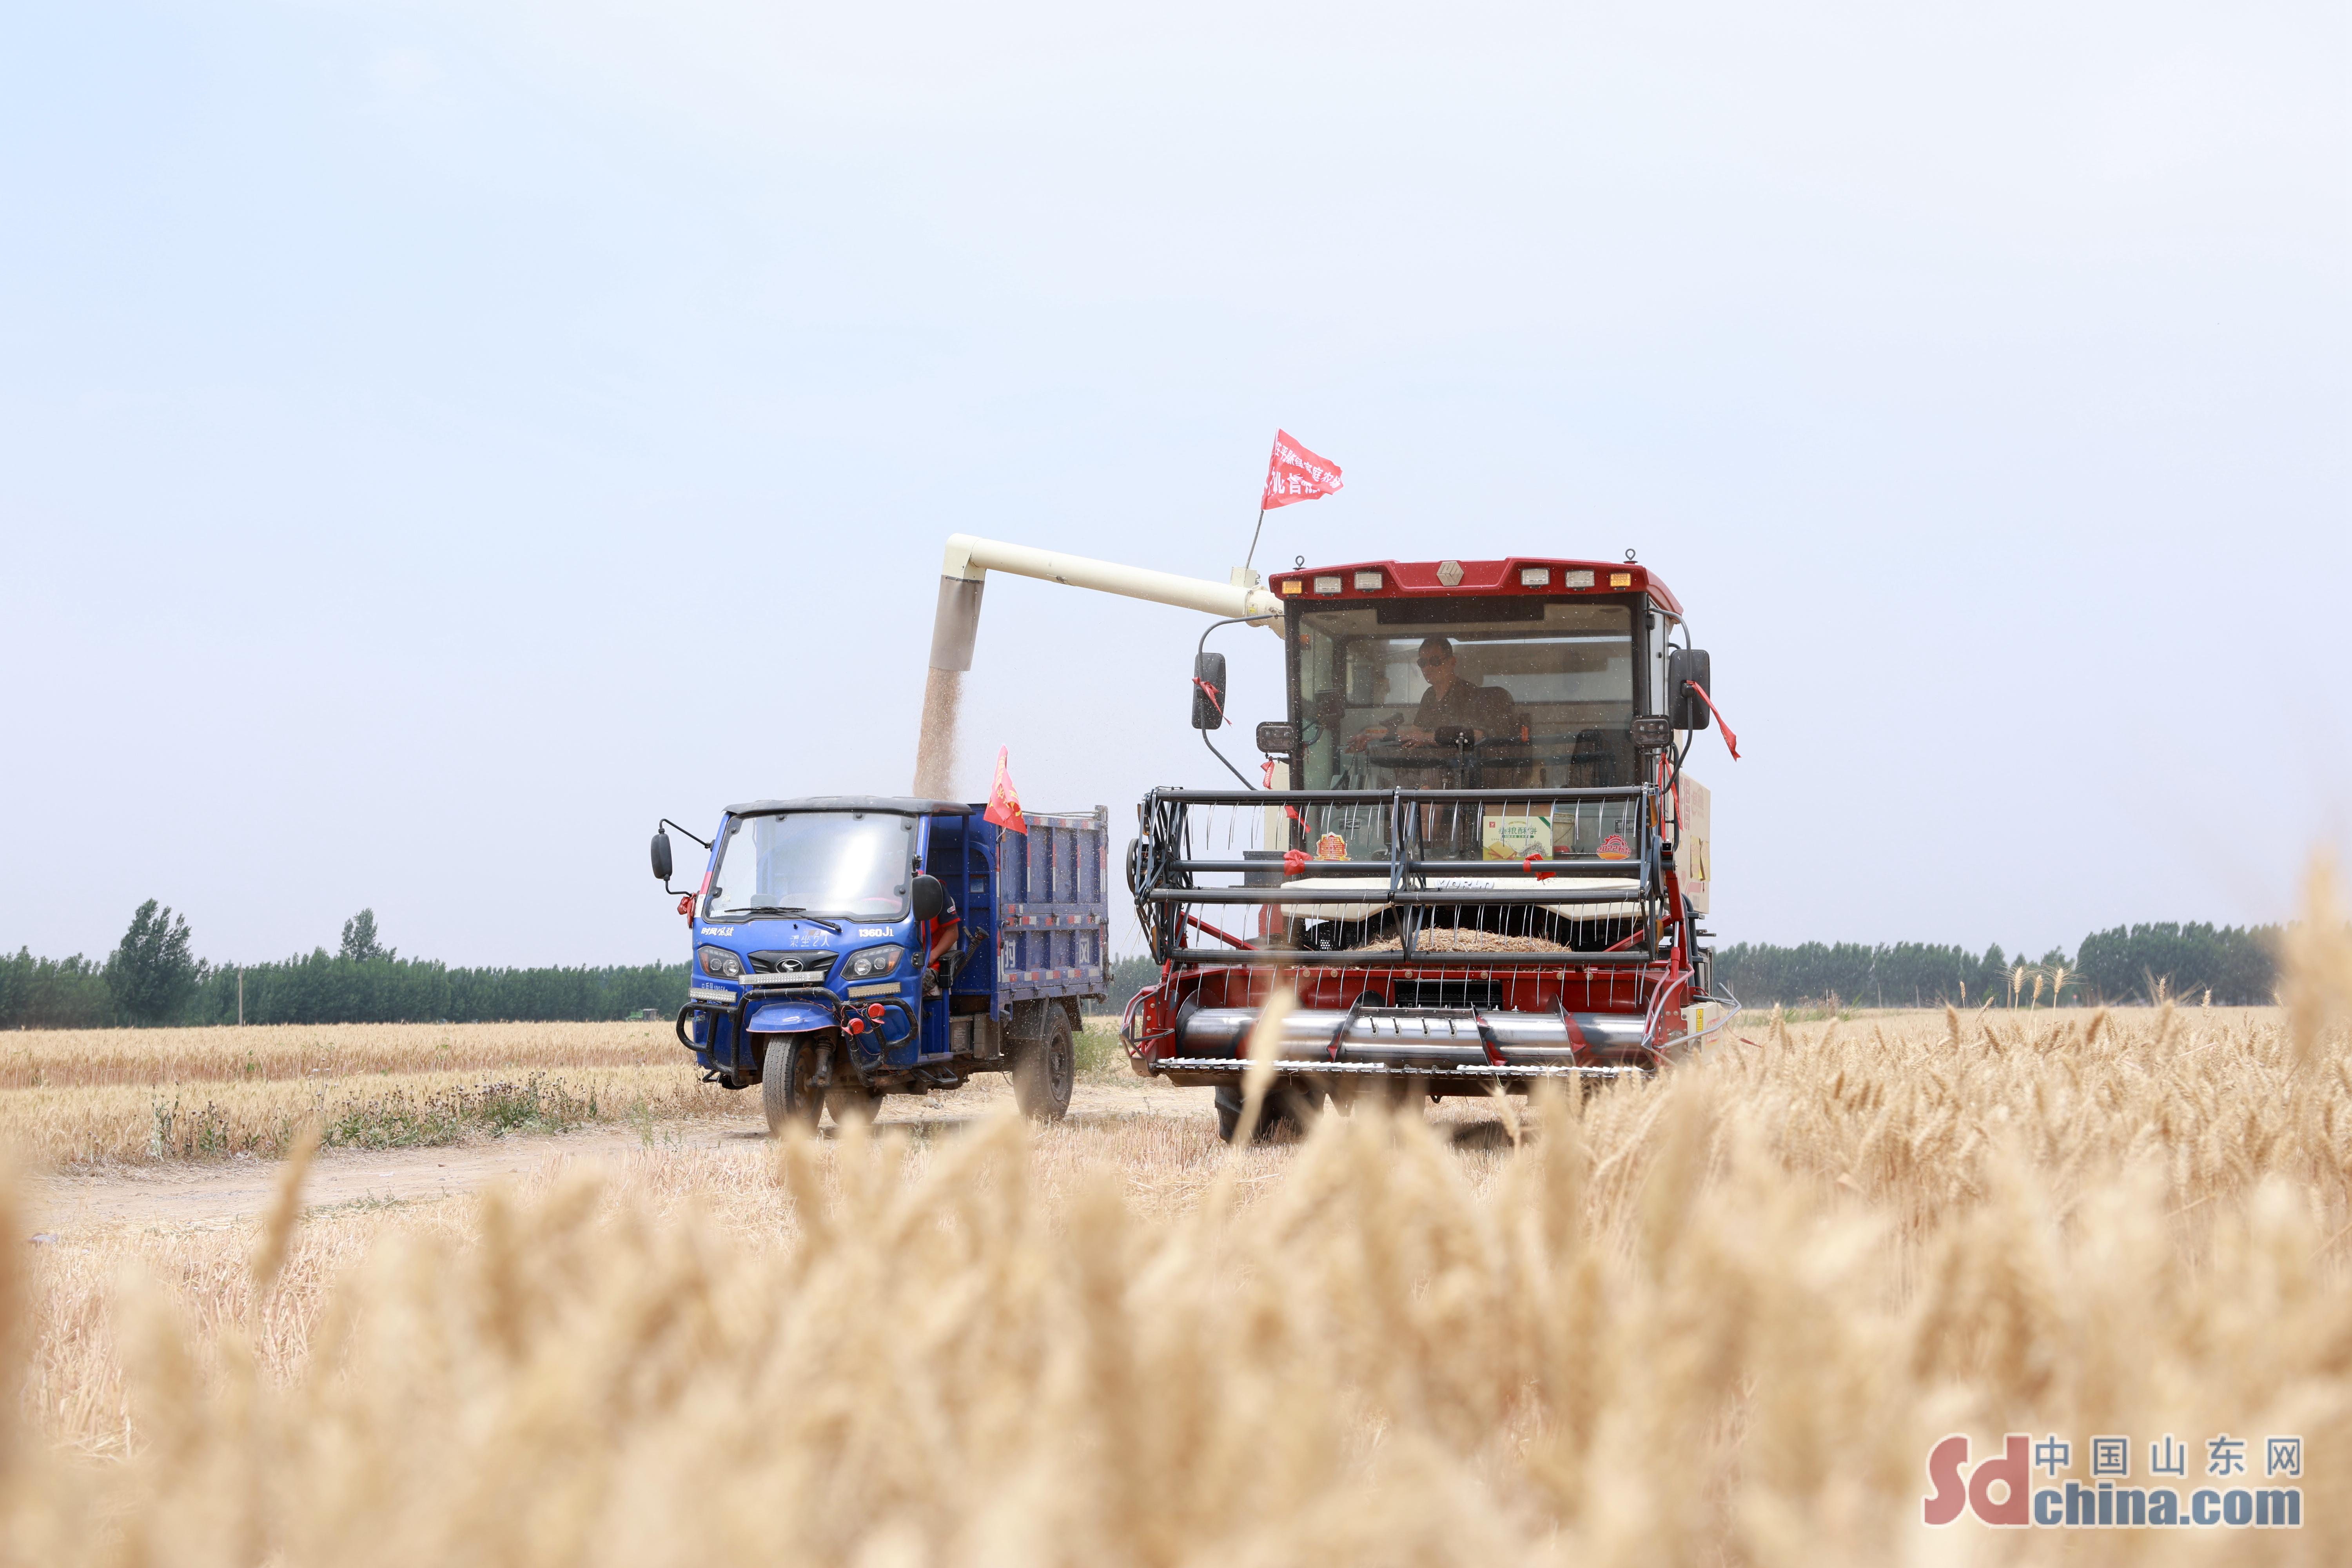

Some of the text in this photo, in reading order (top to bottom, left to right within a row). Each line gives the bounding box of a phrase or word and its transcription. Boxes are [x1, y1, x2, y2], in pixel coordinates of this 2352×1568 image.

[1597, 845, 1631, 856] 2022新款
[789, 935, 830, 947] 乘坐2人
